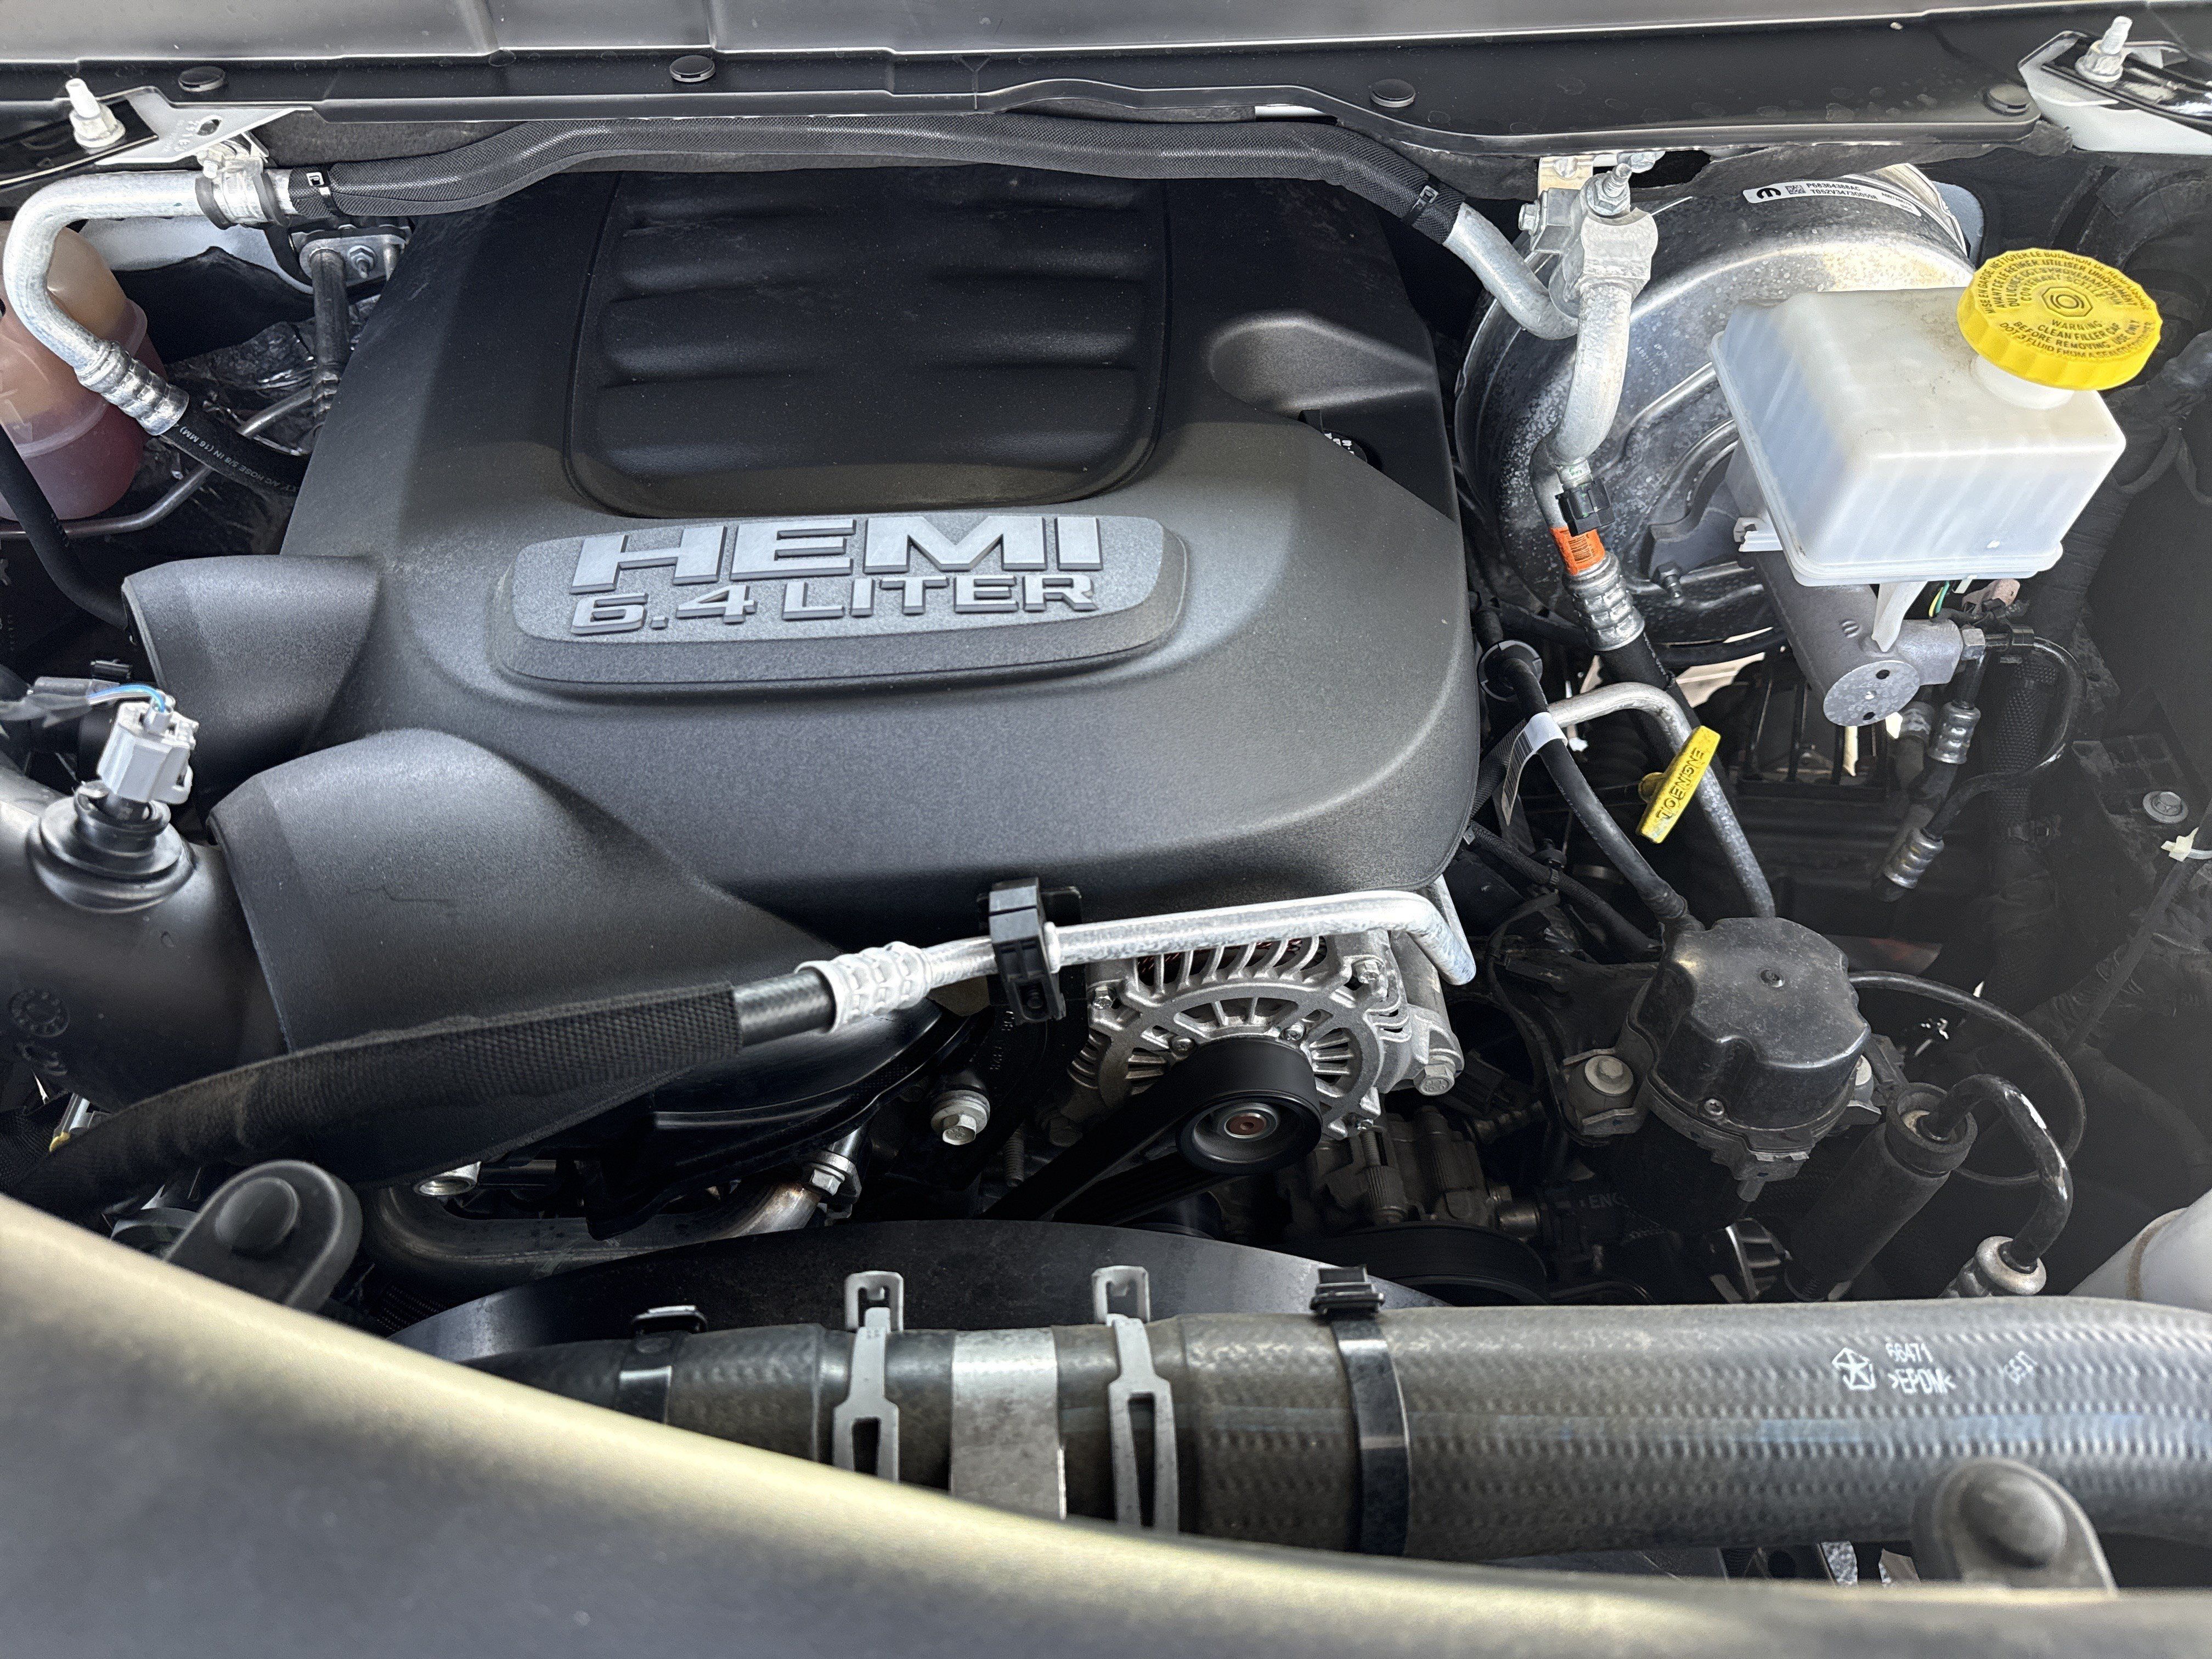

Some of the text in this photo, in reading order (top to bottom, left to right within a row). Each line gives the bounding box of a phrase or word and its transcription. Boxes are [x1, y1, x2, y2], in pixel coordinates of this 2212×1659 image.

[1996, 271, 2010, 281] LE
[1977, 289, 1989, 298] EN
[1991, 287, 2007, 308] AVANT
[1979, 300, 1996, 314] MISE
[2006, 297, 2020, 307] DU
[1999, 322, 2020, 335] DOT
[2025, 337, 2055, 352] FLUID
[2013, 321, 2052, 343] BEFORE
[2037, 324, 2072, 340] CLEAN
[2074, 330, 2108, 341] FILLER
[179, 426, 200, 443] MM)
[199, 440, 215, 453] (16
[212, 449, 225, 460] IN
[224, 456, 240, 468] 5/8
[238, 465, 266, 481] HOSE
[569, 516, 1103, 594] HEMI
[570, 574, 1098, 635] 6.4 LITER
[1656, 747, 1706, 819] ENGINE OIL
